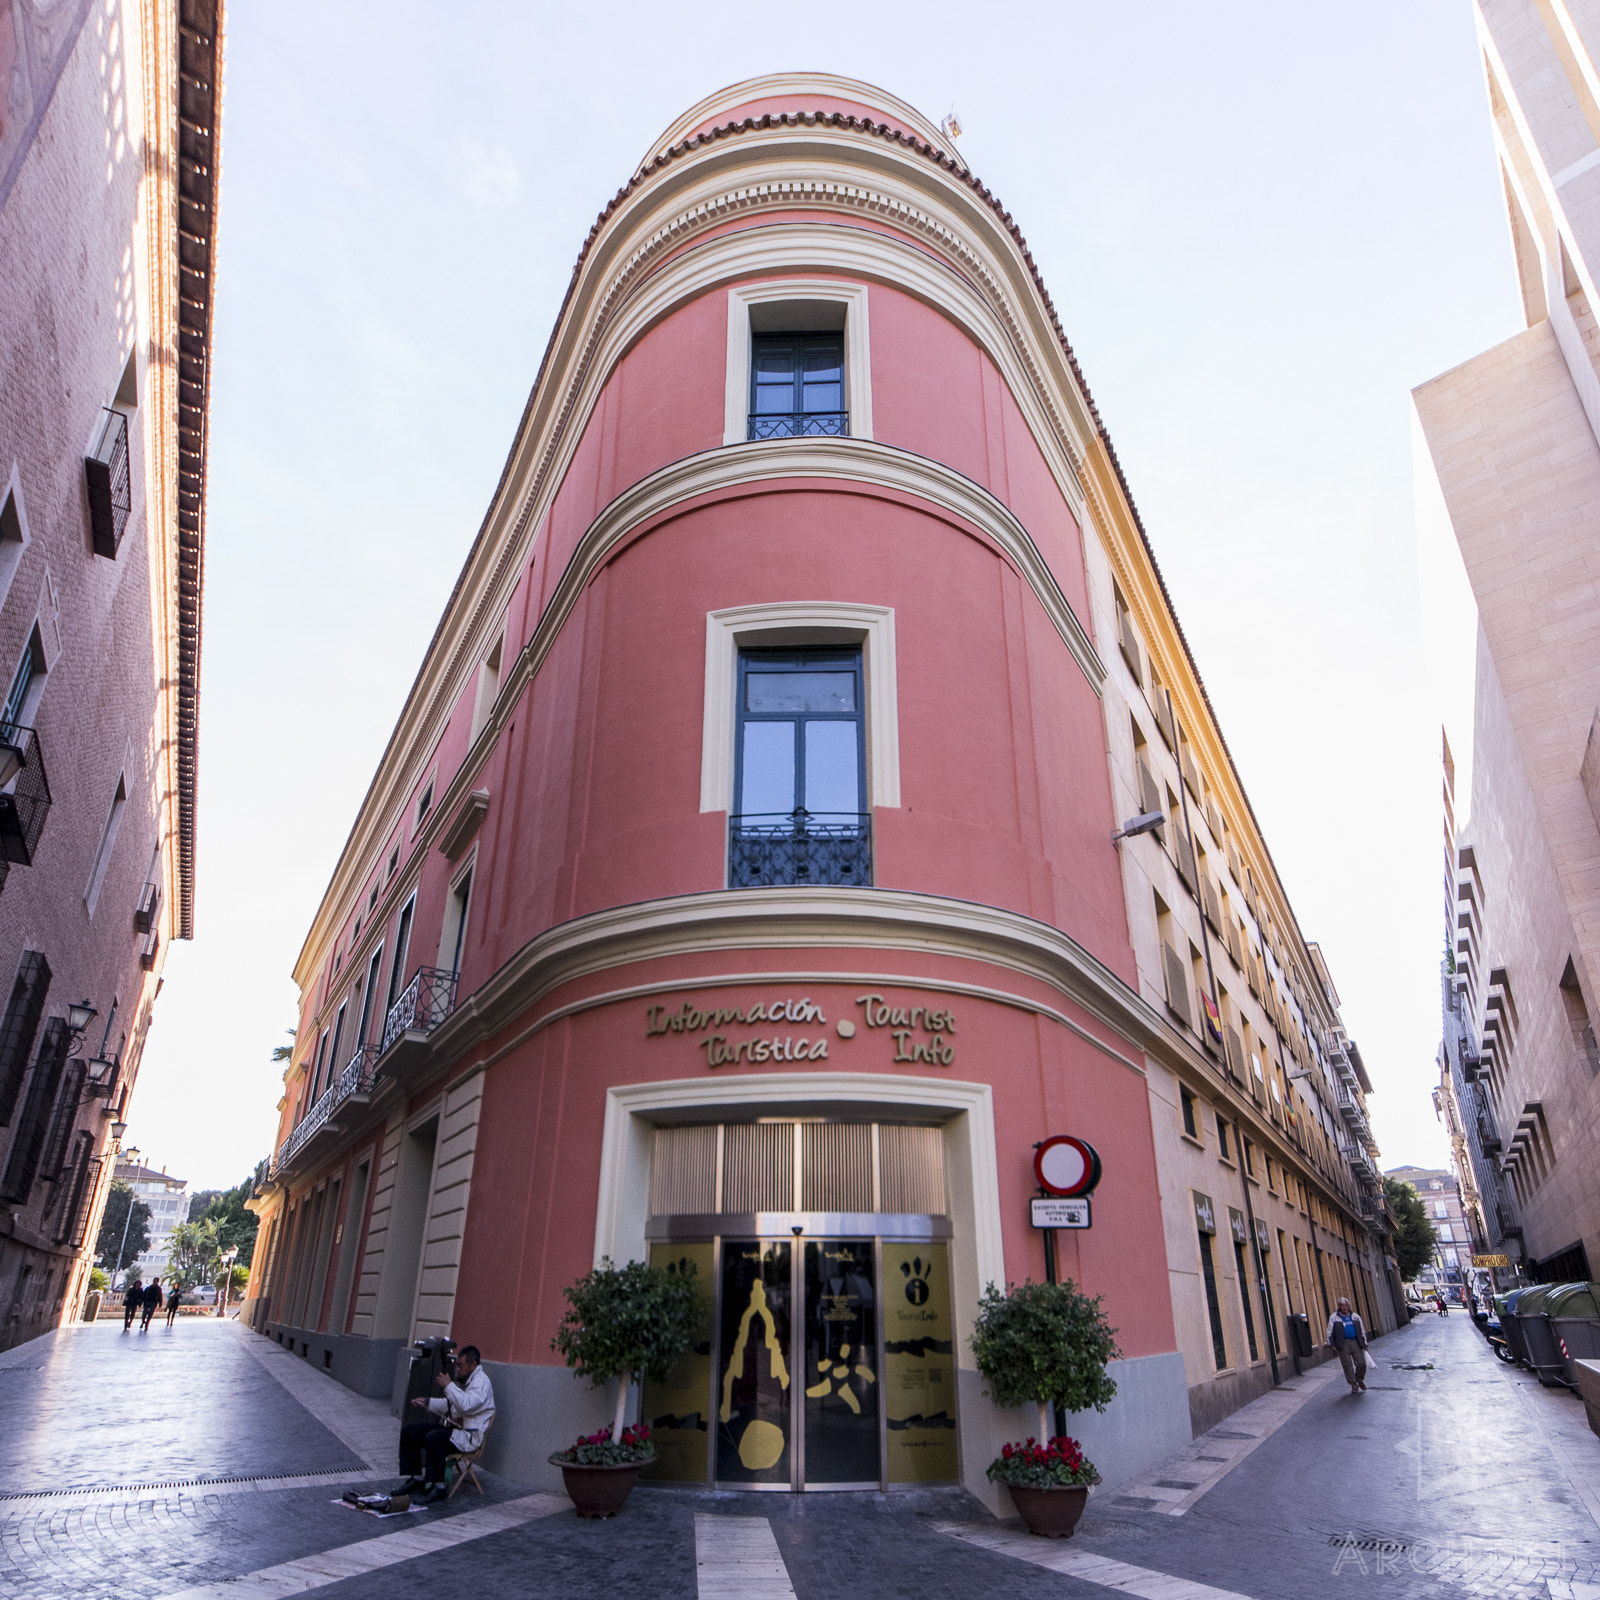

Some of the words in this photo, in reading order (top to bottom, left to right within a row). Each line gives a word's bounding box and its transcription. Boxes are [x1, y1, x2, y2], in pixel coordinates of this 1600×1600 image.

[646, 997, 826, 1036] Información
[856, 993, 957, 1033] Tourist
[700, 1033, 829, 1067] Turística
[891, 1029, 956, 1066] Info
[1471, 1255, 1496, 1267] COMPRO
[1496, 1255, 1510, 1266] ORO
